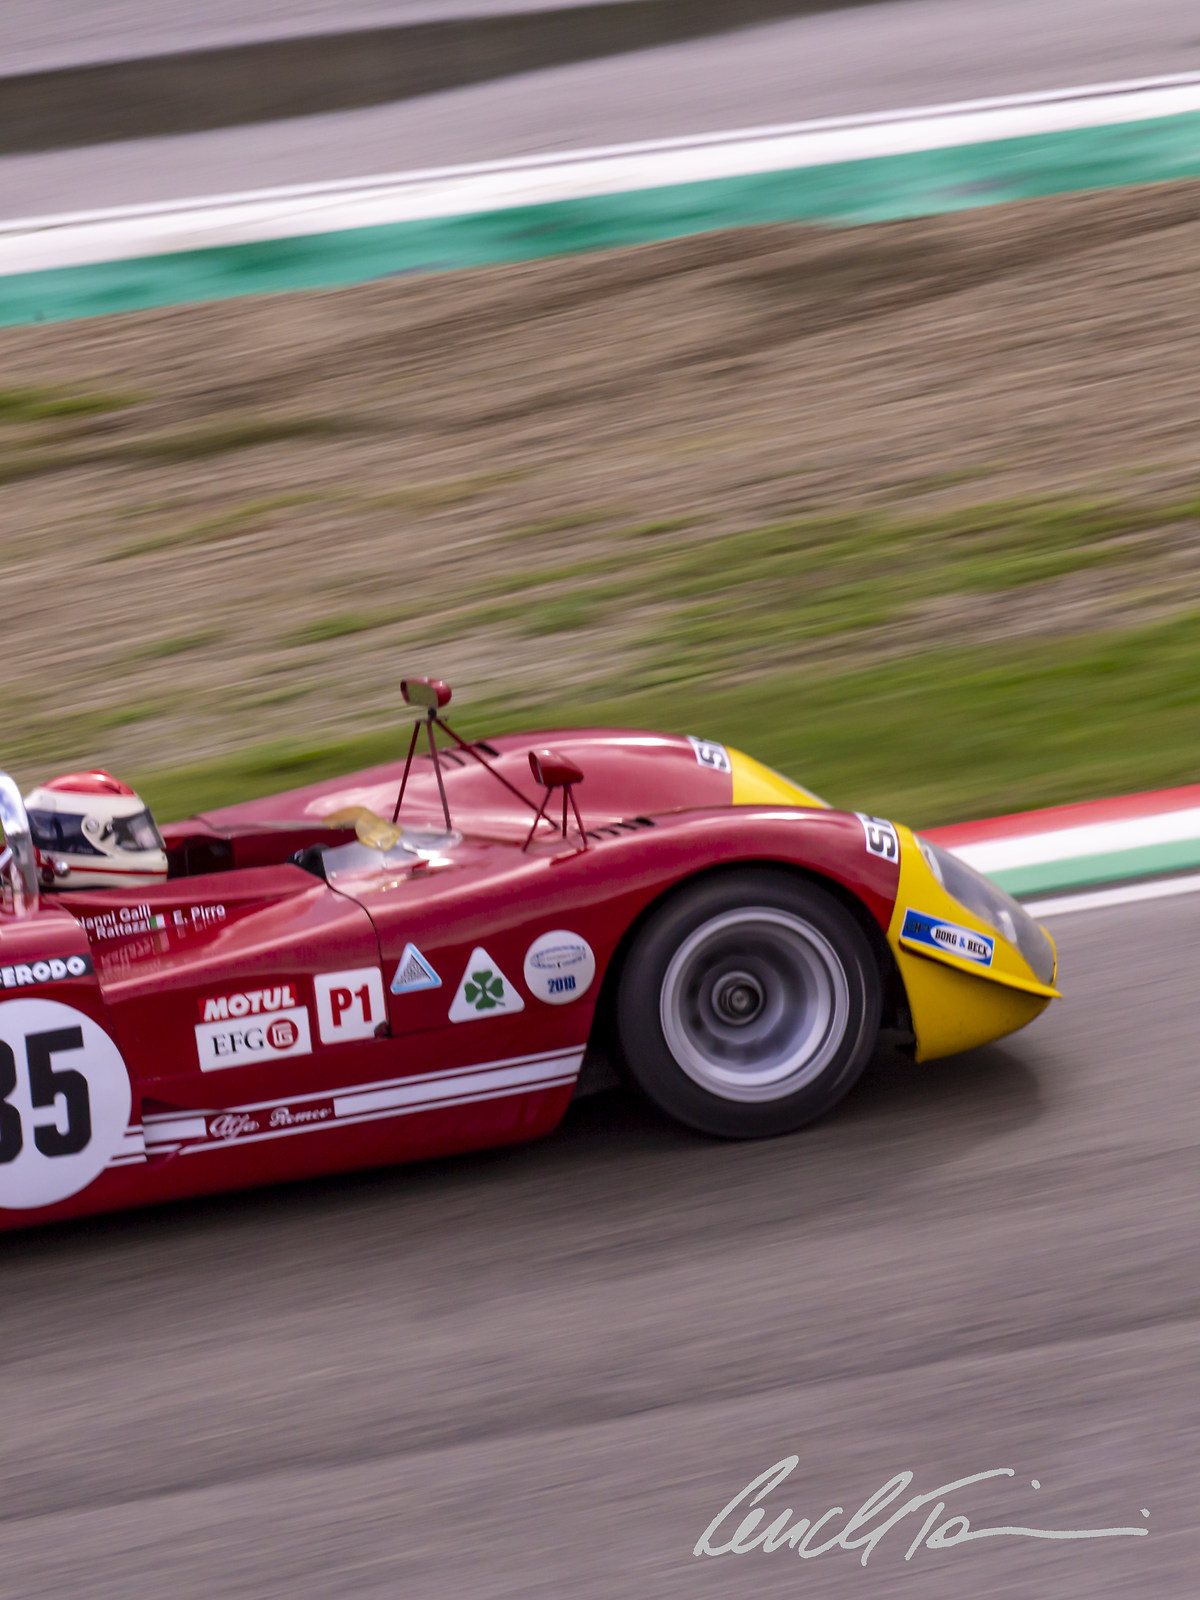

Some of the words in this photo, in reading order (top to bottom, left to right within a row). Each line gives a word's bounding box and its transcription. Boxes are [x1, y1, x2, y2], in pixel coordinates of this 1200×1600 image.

[191, 904, 225, 921] Pirro
[935, 928, 957, 945] BORG
[547, 974, 577, 994] 2018
[203, 985, 296, 1022] MOTUL
[329, 983, 372, 1028] P1
[212, 1027, 264, 1057] EFG
[209, 1112, 260, 1140] Alfa
[269, 1106, 332, 1128] Romeo
